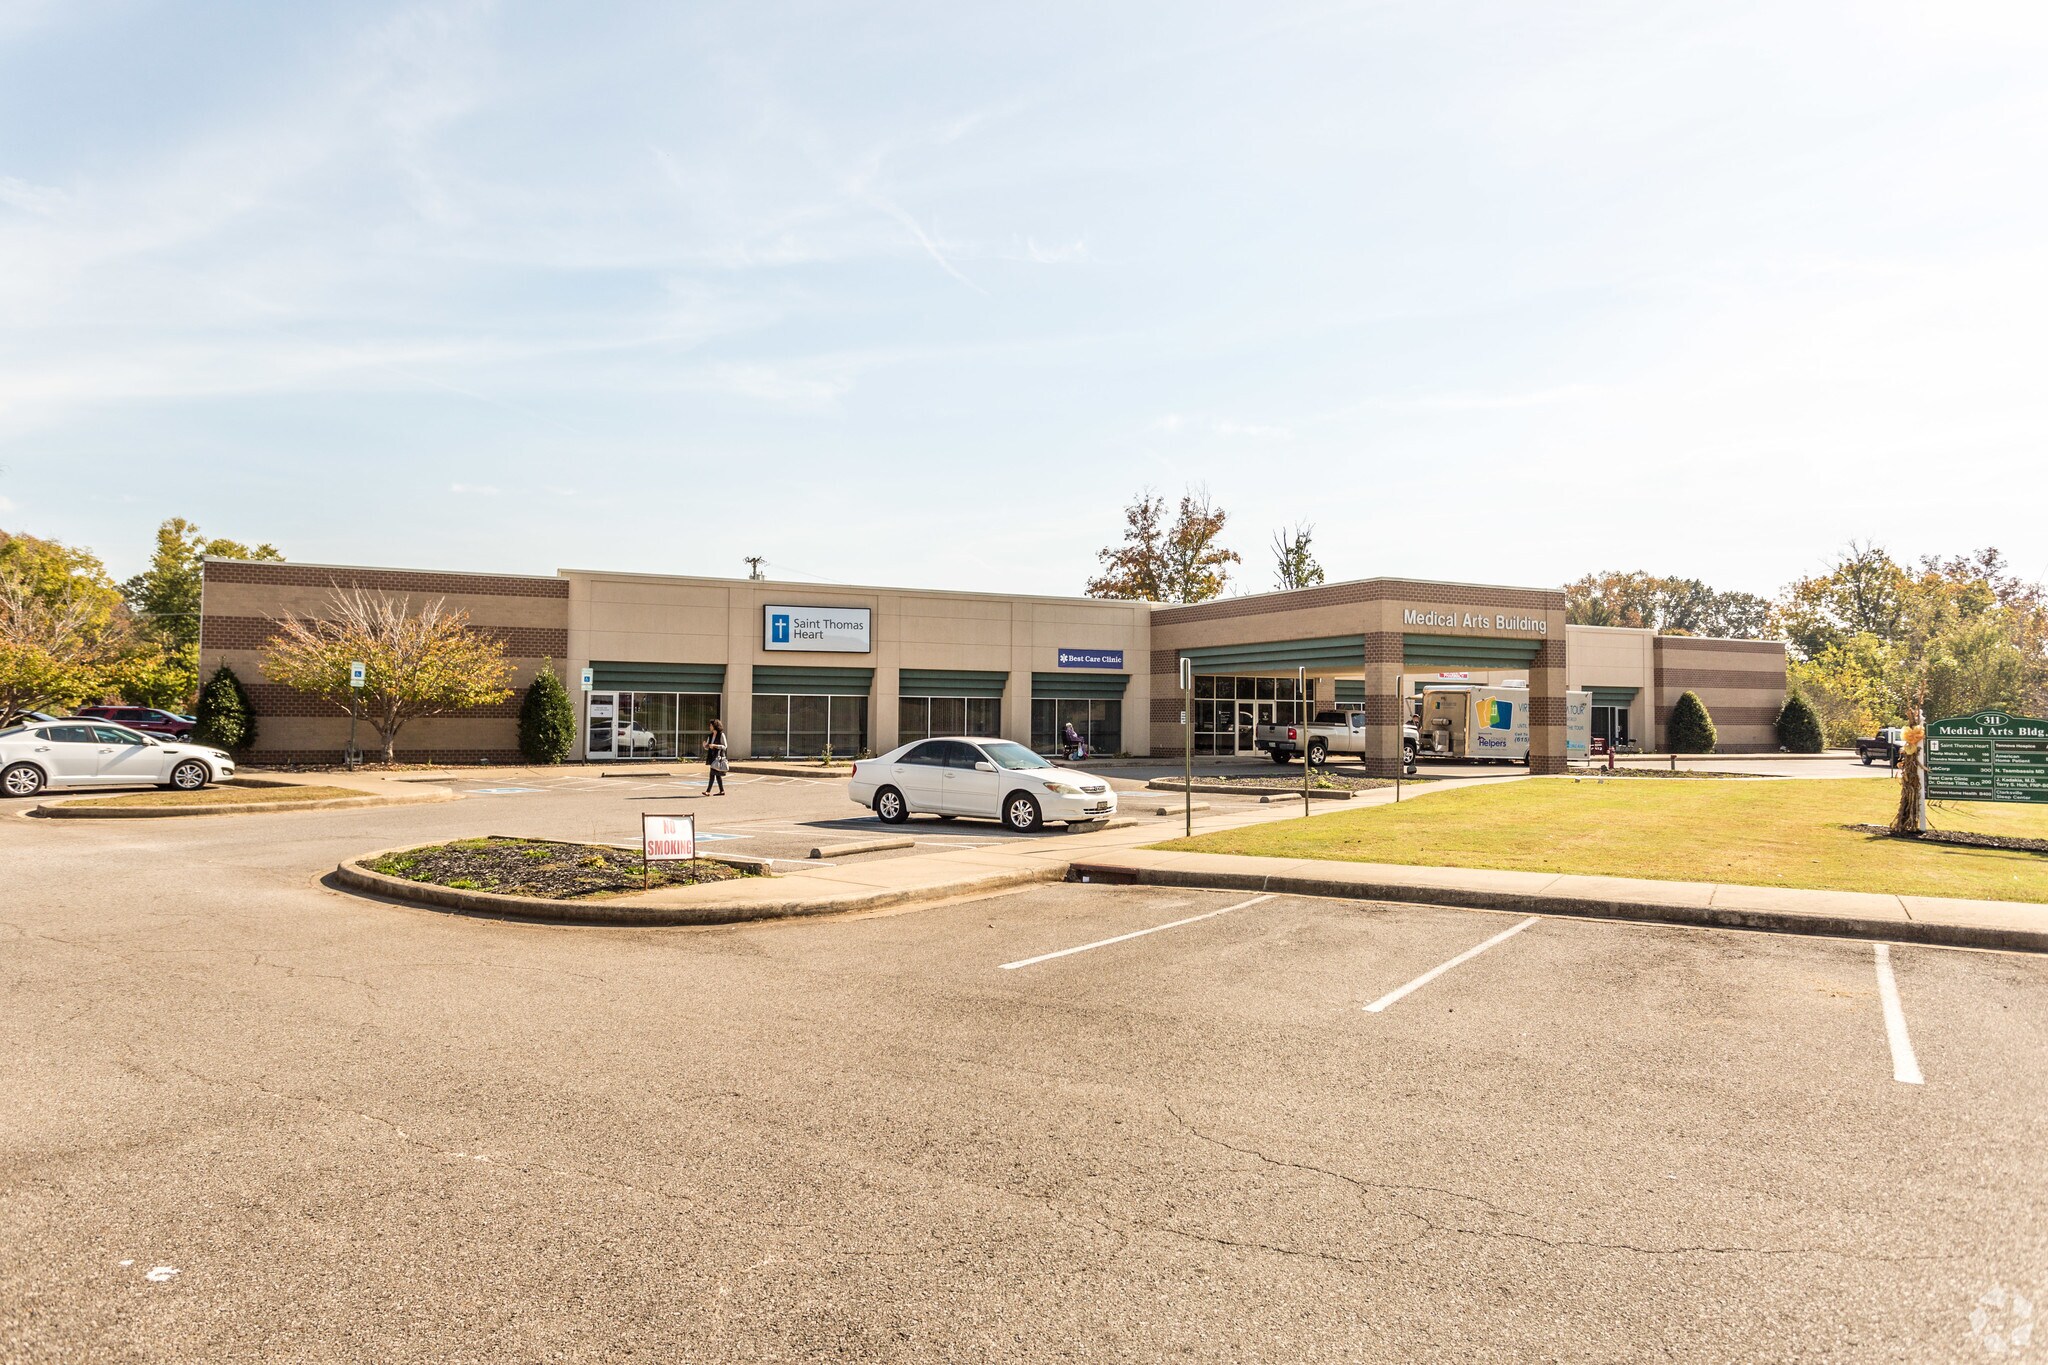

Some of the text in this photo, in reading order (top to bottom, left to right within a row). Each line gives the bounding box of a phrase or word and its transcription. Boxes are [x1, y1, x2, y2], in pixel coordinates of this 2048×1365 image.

[794, 618, 864, 630] Saint Thomas
[1403, 608, 1547, 634] Medical Arts Building
[793, 629, 823, 640] Heart
[1085, 655, 1101, 663] Care
[1570, 705, 1584, 715] TOUR
[1983, 716, 2000, 725] 311
[1939, 727, 2048, 737] Medical Arts Bldg.
[1478, 739, 1507, 748] Helpers
[663, 820, 676, 835] NO
[647, 839, 692, 856] SMOKING
